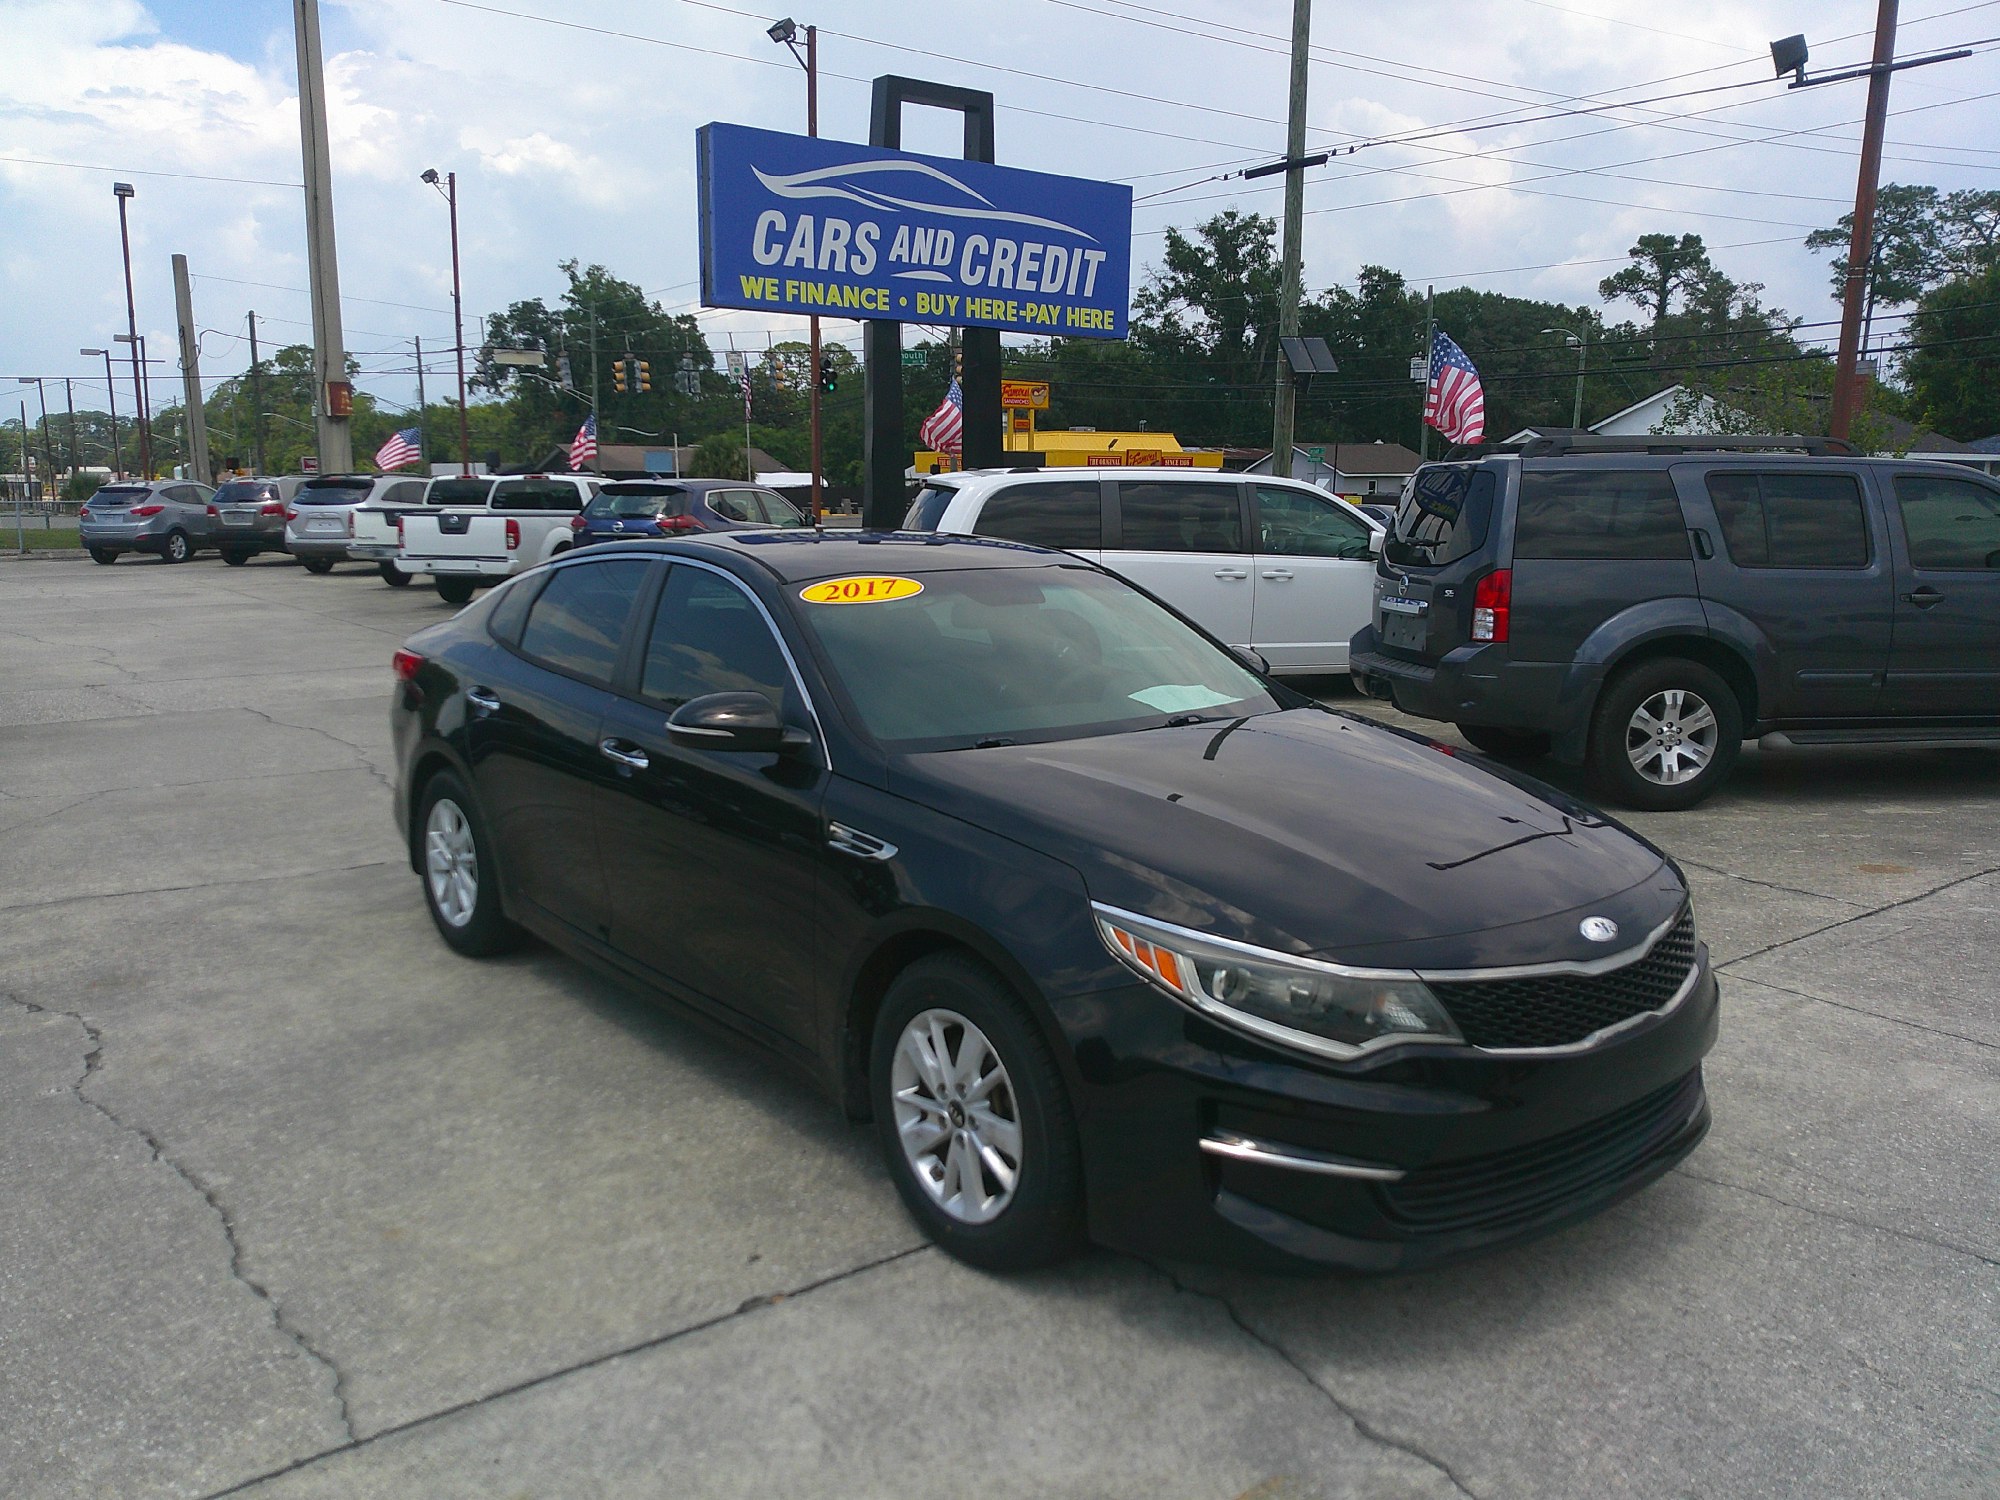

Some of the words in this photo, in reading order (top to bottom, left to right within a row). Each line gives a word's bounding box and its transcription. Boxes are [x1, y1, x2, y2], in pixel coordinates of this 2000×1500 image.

[753, 209, 881, 276] CARS
[888, 224, 955, 266] AND
[959, 234, 1107, 297] CREDIT
[739, 274, 780, 301] WE
[786, 279, 890, 311] FINANCE
[916, 292, 960, 316] BUY
[966, 297, 1061, 325] HERE-PAY
[1066, 306, 1114, 330] HERE
[824, 579, 898, 600] 2017
